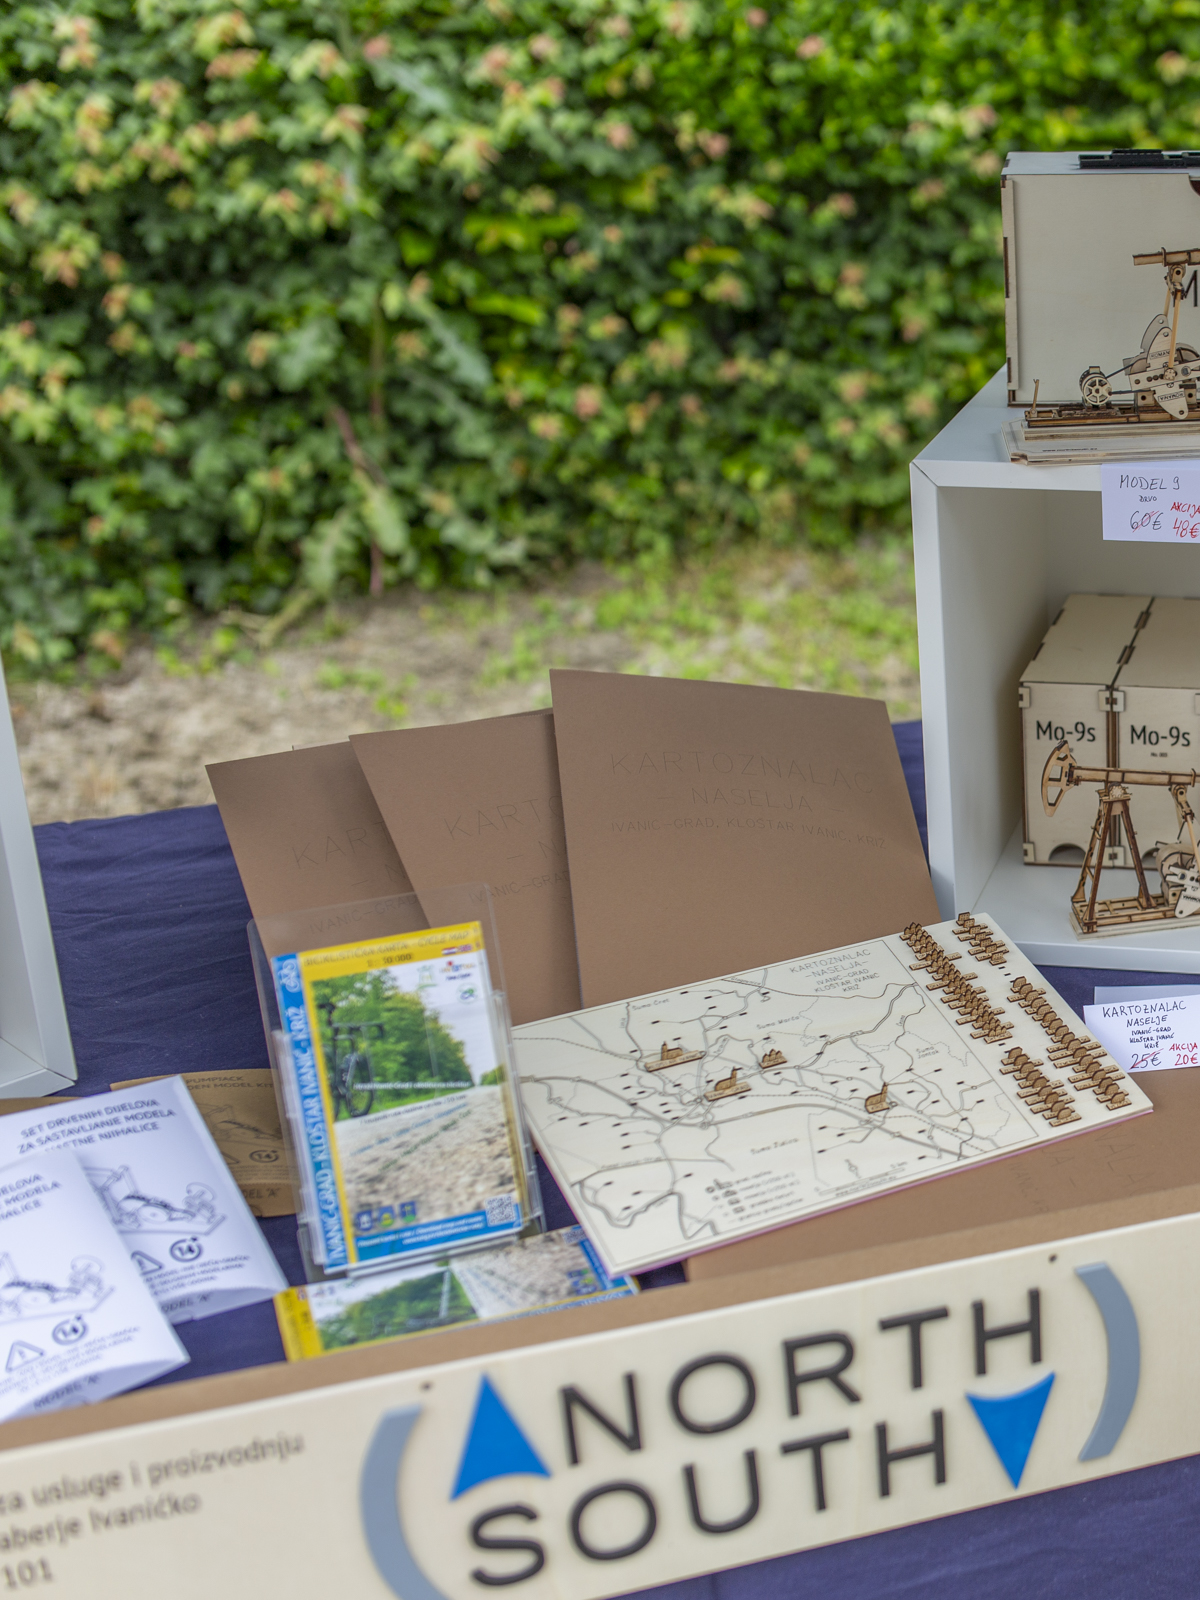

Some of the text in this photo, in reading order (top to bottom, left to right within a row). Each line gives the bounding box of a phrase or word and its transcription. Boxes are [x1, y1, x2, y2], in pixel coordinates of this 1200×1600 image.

[1120, 475, 1180, 490] MODEL 9
[1130, 511, 1163, 530] 60€
[1170, 501, 1200, 518] AKCIJA
[1173, 518, 1200, 538] 48€
[1035, 720, 1096, 742] Mo-9s
[1130, 724, 1191, 747] Mo-9s
[610, 751, 873, 794] KARTOZNALAC
[691, 787, 813, 813] NASELJA
[789, 949, 871, 974] KARTOZNALAC
[1102, 1000, 1187, 1018] KARTOZNALAC
[1126, 1014, 1168, 1028] NASELJE
[1168, 1042, 1198, 1053] AKCIJA
[1130, 1052, 1162, 1069] 25€
[1174, 1053, 1198, 1066] 20€
[186, 1076, 243, 1084] PUMPJACK
[20, 1098, 161, 1138] SET DRVENIH DIJELOVA
[17, 1142, 36, 1154] ZA
[36, 1116, 122, 1146] SASTAVLJANJE
[123, 1108, 177, 1123] MODELA
[4, 1180, 63, 1206] MODELA
[559, 1287, 1043, 1467] NORTH
[31, 1469, 123, 1508] usluge
[129, 1461, 141, 1486] i
[147, 1432, 305, 1486] proizvodnju
[470, 1408, 946, 1588] SOUTH
[0, 1516, 81, 1549] aberje
[1, 1556, 54, 1590] 101
